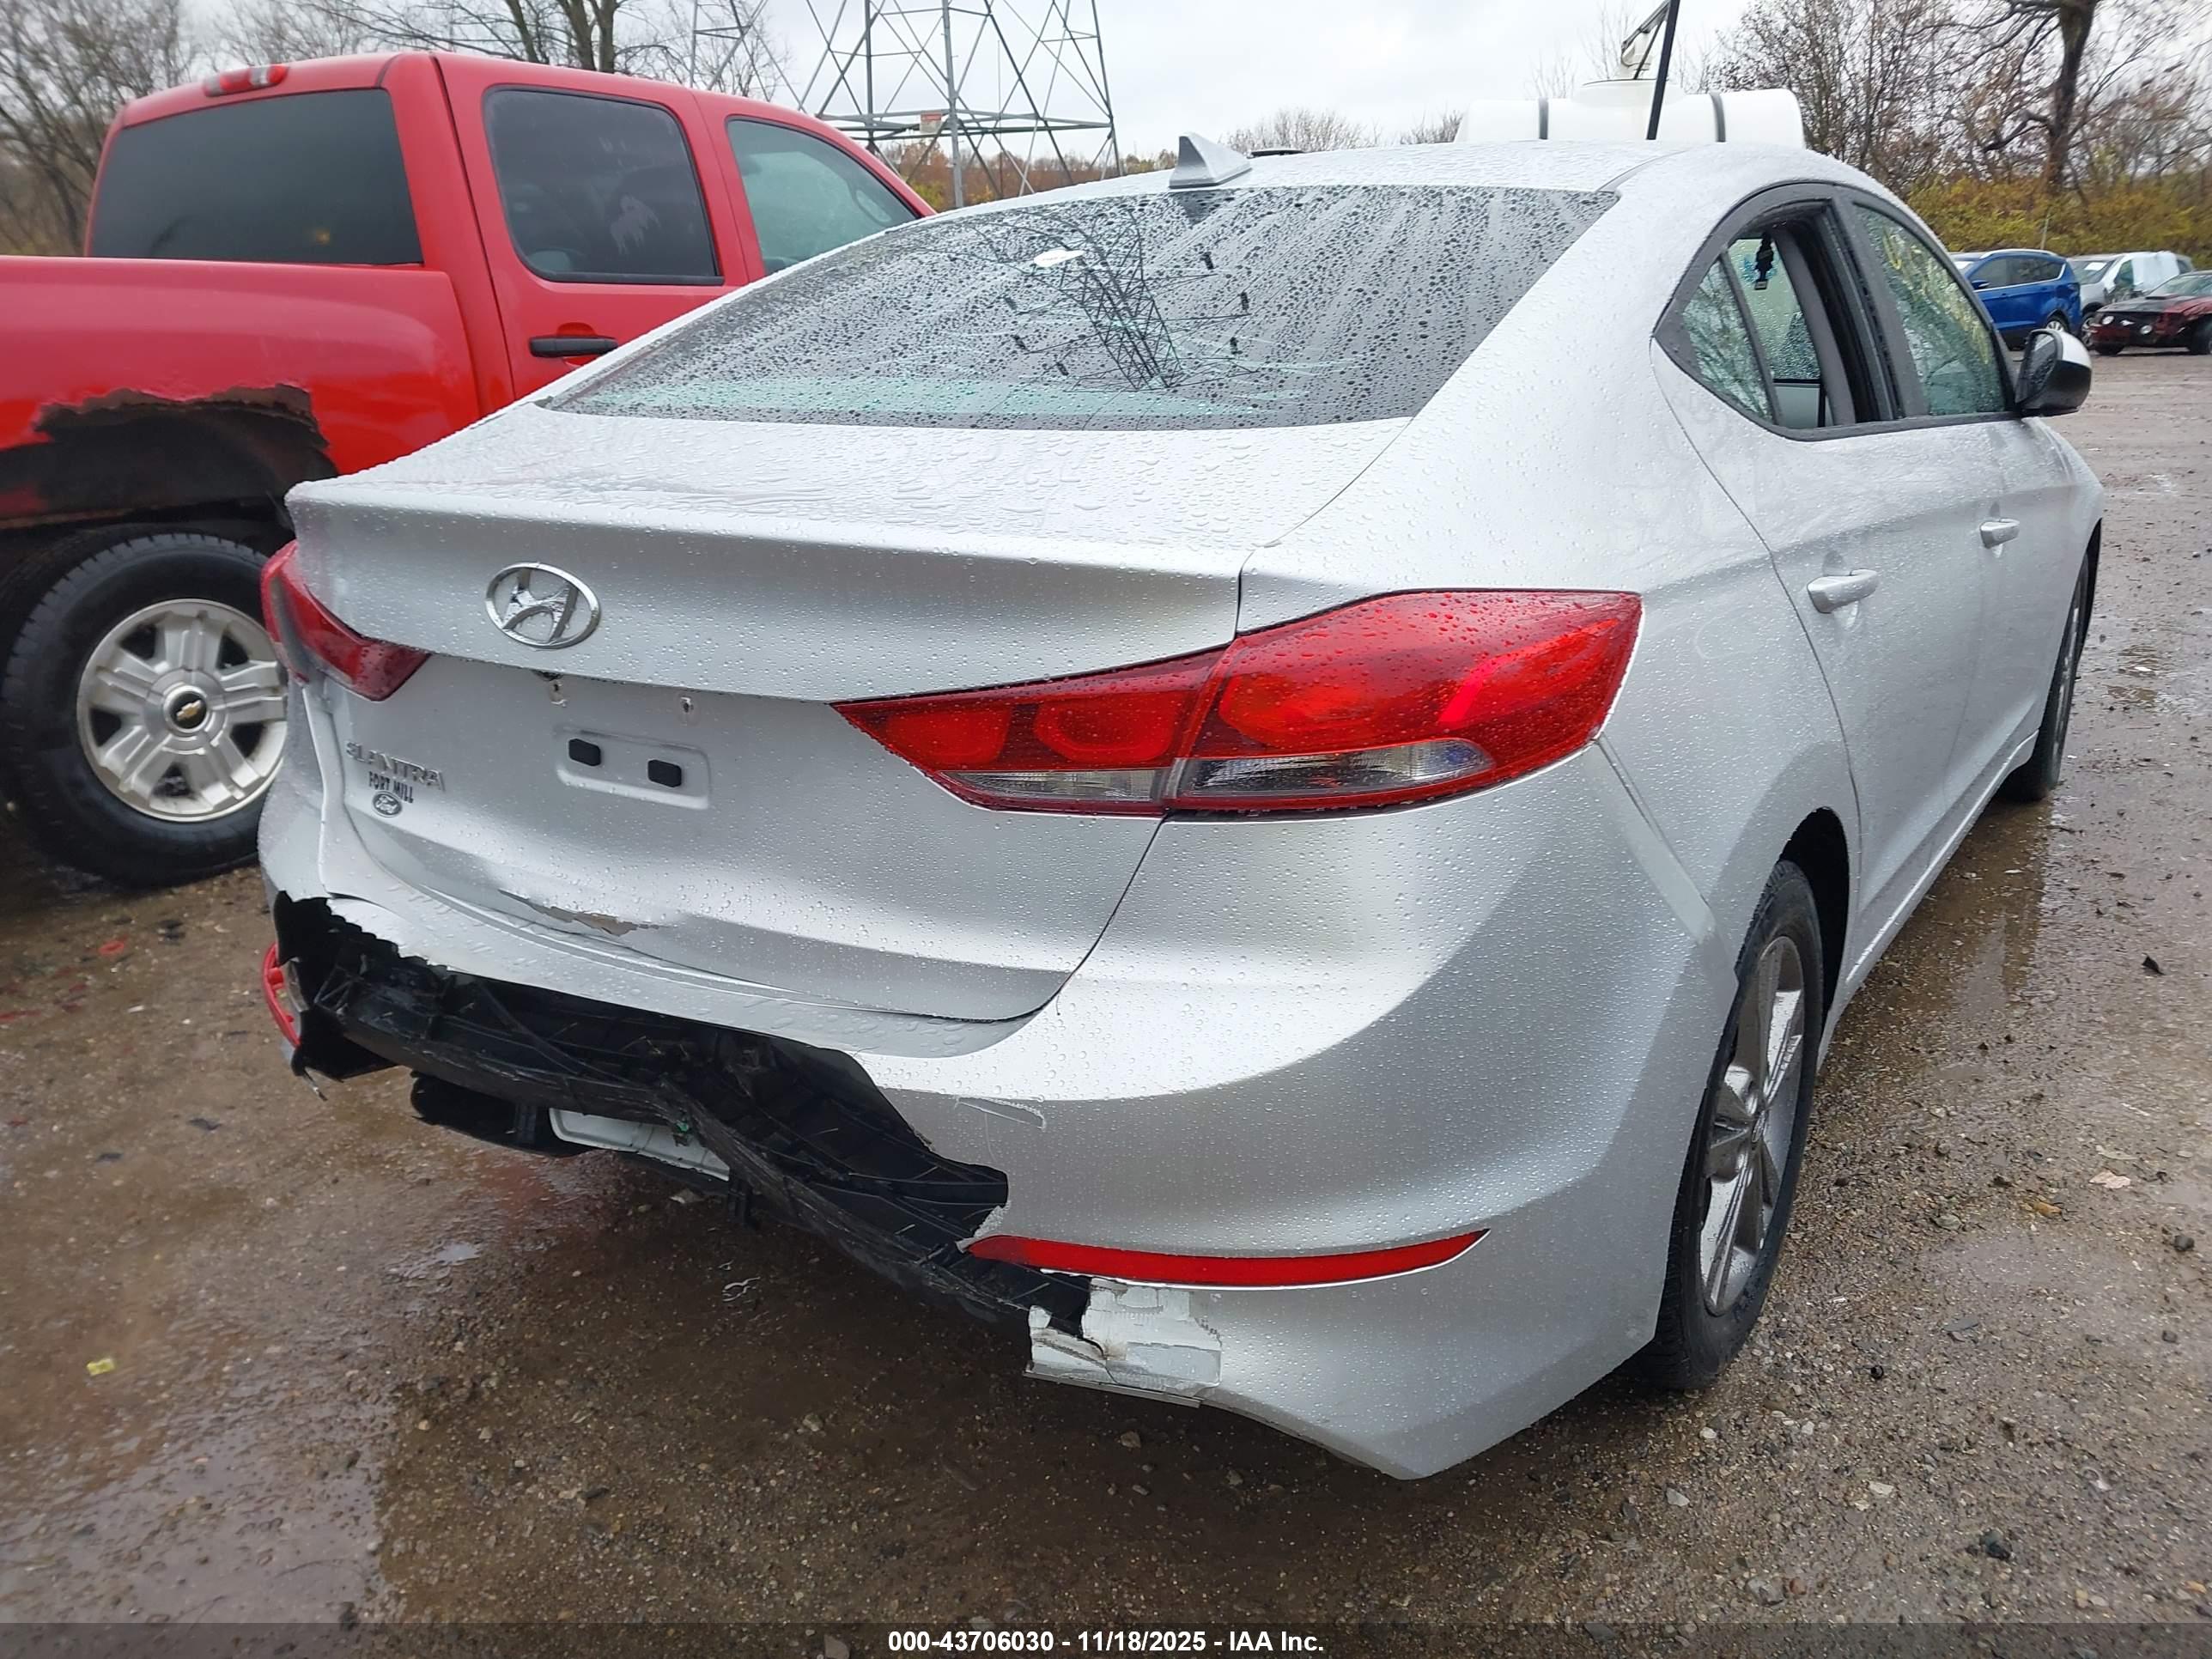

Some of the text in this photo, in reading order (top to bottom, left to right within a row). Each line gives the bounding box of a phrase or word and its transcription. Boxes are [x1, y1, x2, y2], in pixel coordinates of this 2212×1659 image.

[345, 741, 446, 793] ELANTRA
[368, 771, 415, 804] FORT MILL
